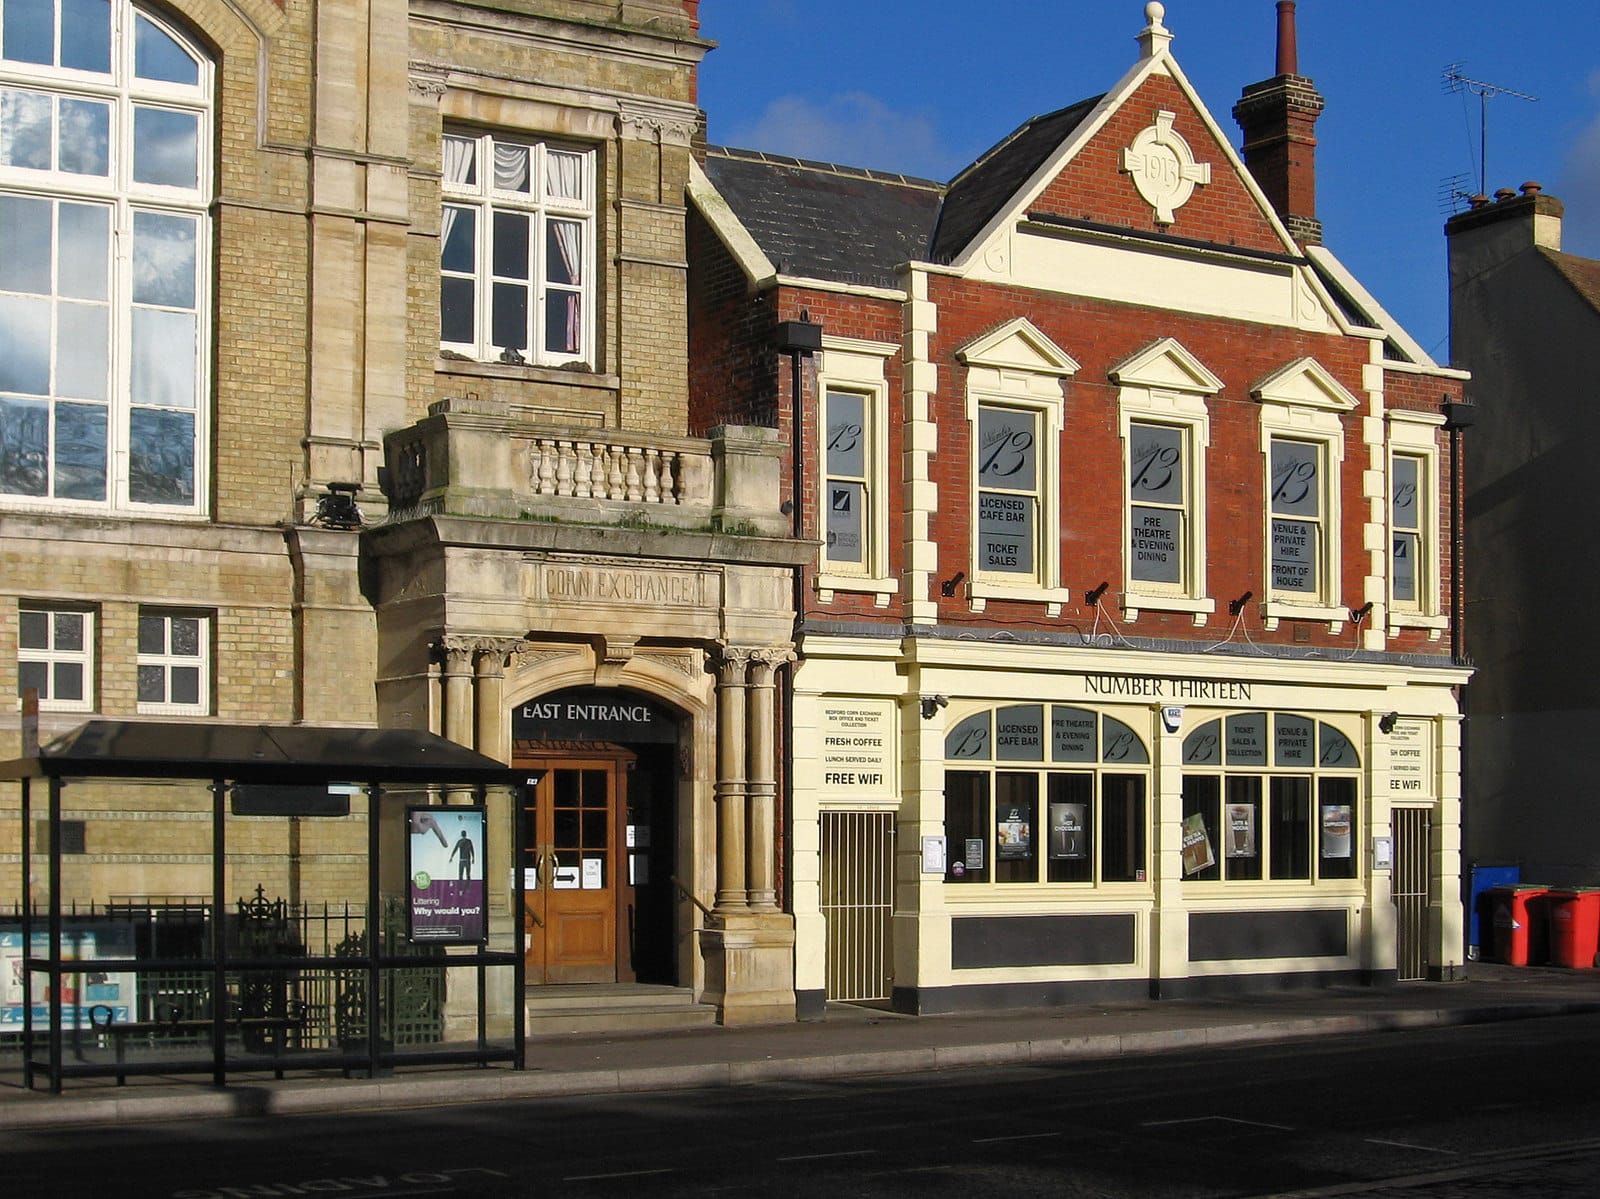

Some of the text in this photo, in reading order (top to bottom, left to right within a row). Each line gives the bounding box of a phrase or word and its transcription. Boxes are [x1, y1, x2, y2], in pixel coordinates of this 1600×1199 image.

[1142, 153, 1176, 188] 1913
[979, 431, 1033, 477] 13
[1131, 447, 1180, 491] 13
[1271, 461, 1316, 504] 13
[980, 498, 1025, 511] LICENSED
[1006, 512, 1025, 522] BAR
[1144, 516, 1161, 527] PRE
[1134, 527, 1171, 540] THEATRE
[1272, 523, 1307, 535] VENUE &
[1138, 540, 1175, 551] EVENING
[1274, 534, 1306, 546] PRIVATE
[987, 543, 1019, 555] TICKET
[1280, 546, 1300, 557] HIRE
[988, 555, 1017, 567] SALES
[1138, 551, 1167, 562] DINING
[1272, 565, 1309, 576] FRONT OF
[546, 569, 590, 597] CORN
[1276, 576, 1304, 587] HOUSE
[1085, 676, 1251, 701] NUMBER THIRTEEN
[522, 703, 652, 722] EAST ENTRANCE
[998, 724, 1039, 735] LICENSED
[1066, 720, 1094, 729] THEATRE
[1234, 726, 1255, 734] TICKET
[1062, 731, 1090, 740] EVENING
[1277, 727, 1308, 736] VENUE &
[825, 737, 883, 747] FRESH COFFEE
[953, 728, 987, 757] 13
[1020, 737, 1039, 746] BAR
[1061, 743, 1084, 751] DINING
[1103, 733, 1134, 760] 13
[1278, 738, 1307, 747] PRIVATE
[1188, 735, 1217, 761] 13
[1226, 749, 1262, 757] COLLECTION
[1284, 749, 1302, 758] HIRE
[825, 773, 883, 785] FREE WIFI
[1390, 780, 1421, 790] EE WIFI
[413, 897, 440, 906] Littering
[413, 907, 480, 917] Why would you?
